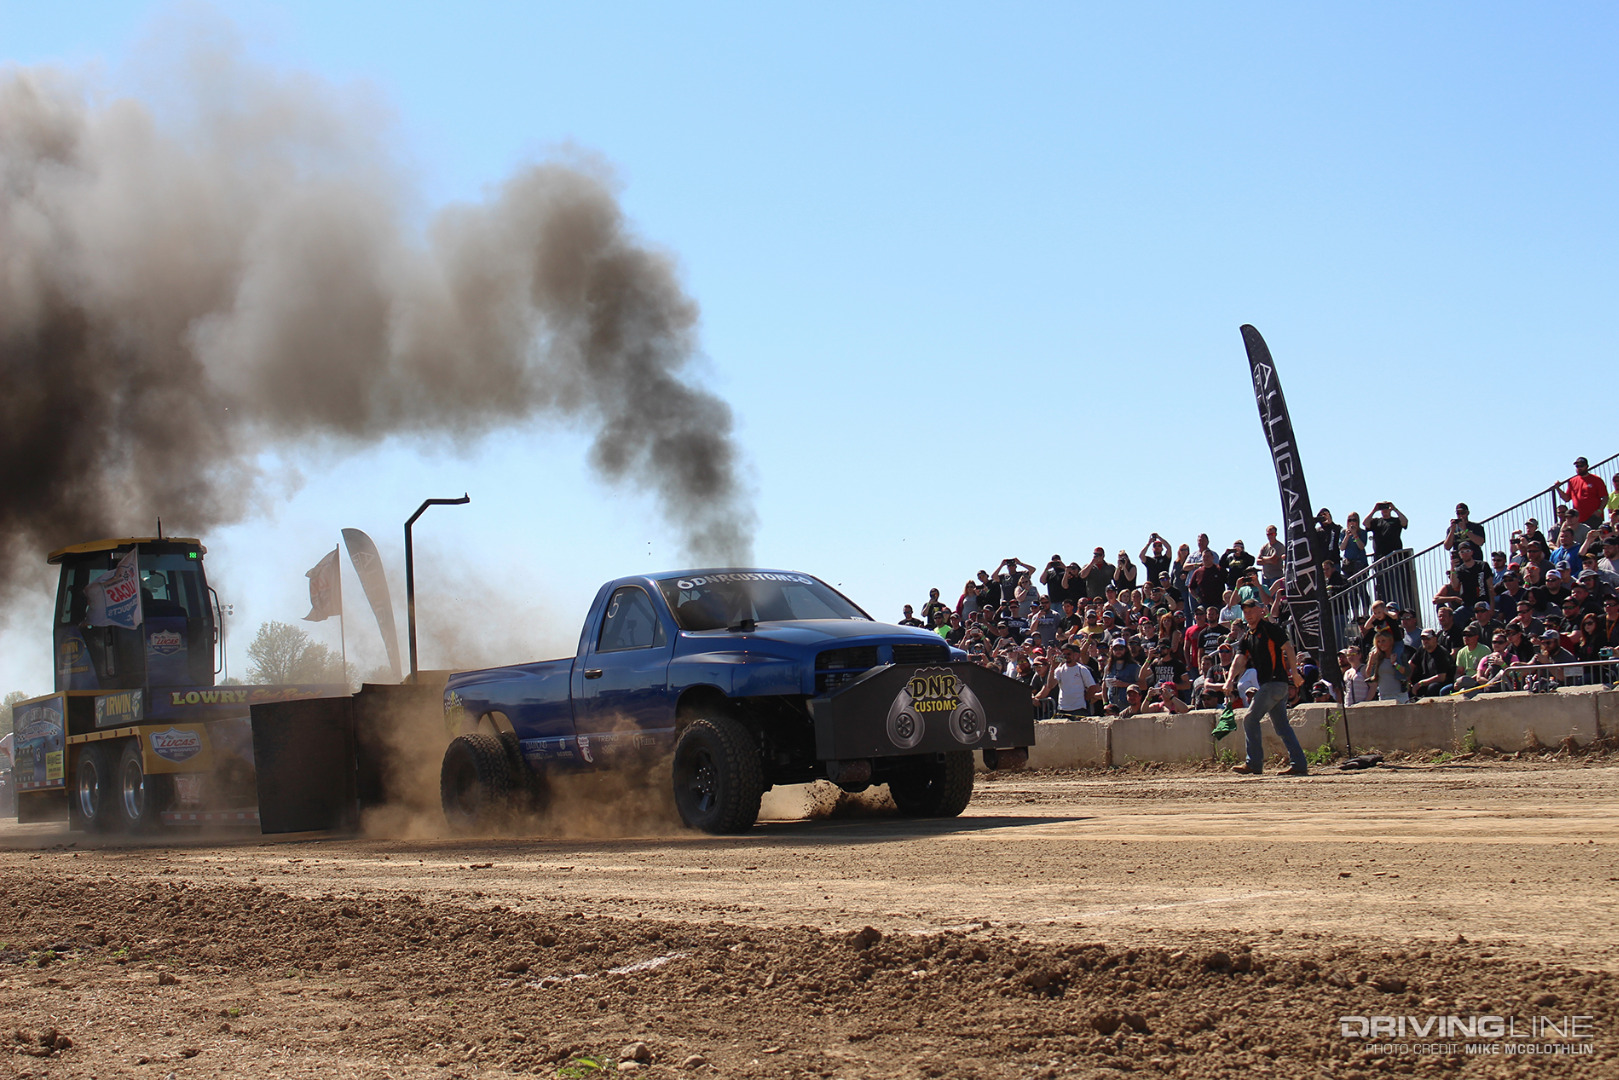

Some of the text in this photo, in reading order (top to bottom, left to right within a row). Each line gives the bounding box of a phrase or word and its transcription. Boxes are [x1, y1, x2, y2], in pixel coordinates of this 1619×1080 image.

[1259, 362, 1318, 595] ALLIGATOR
[607, 592, 624, 618] 5
[172, 690, 248, 705] LOWRY
[910, 675, 959, 699] DNR
[106, 693, 131, 717] IRWIN
[914, 699, 958, 713] CUSTOMS
[160, 738, 197, 748] LUCAS
